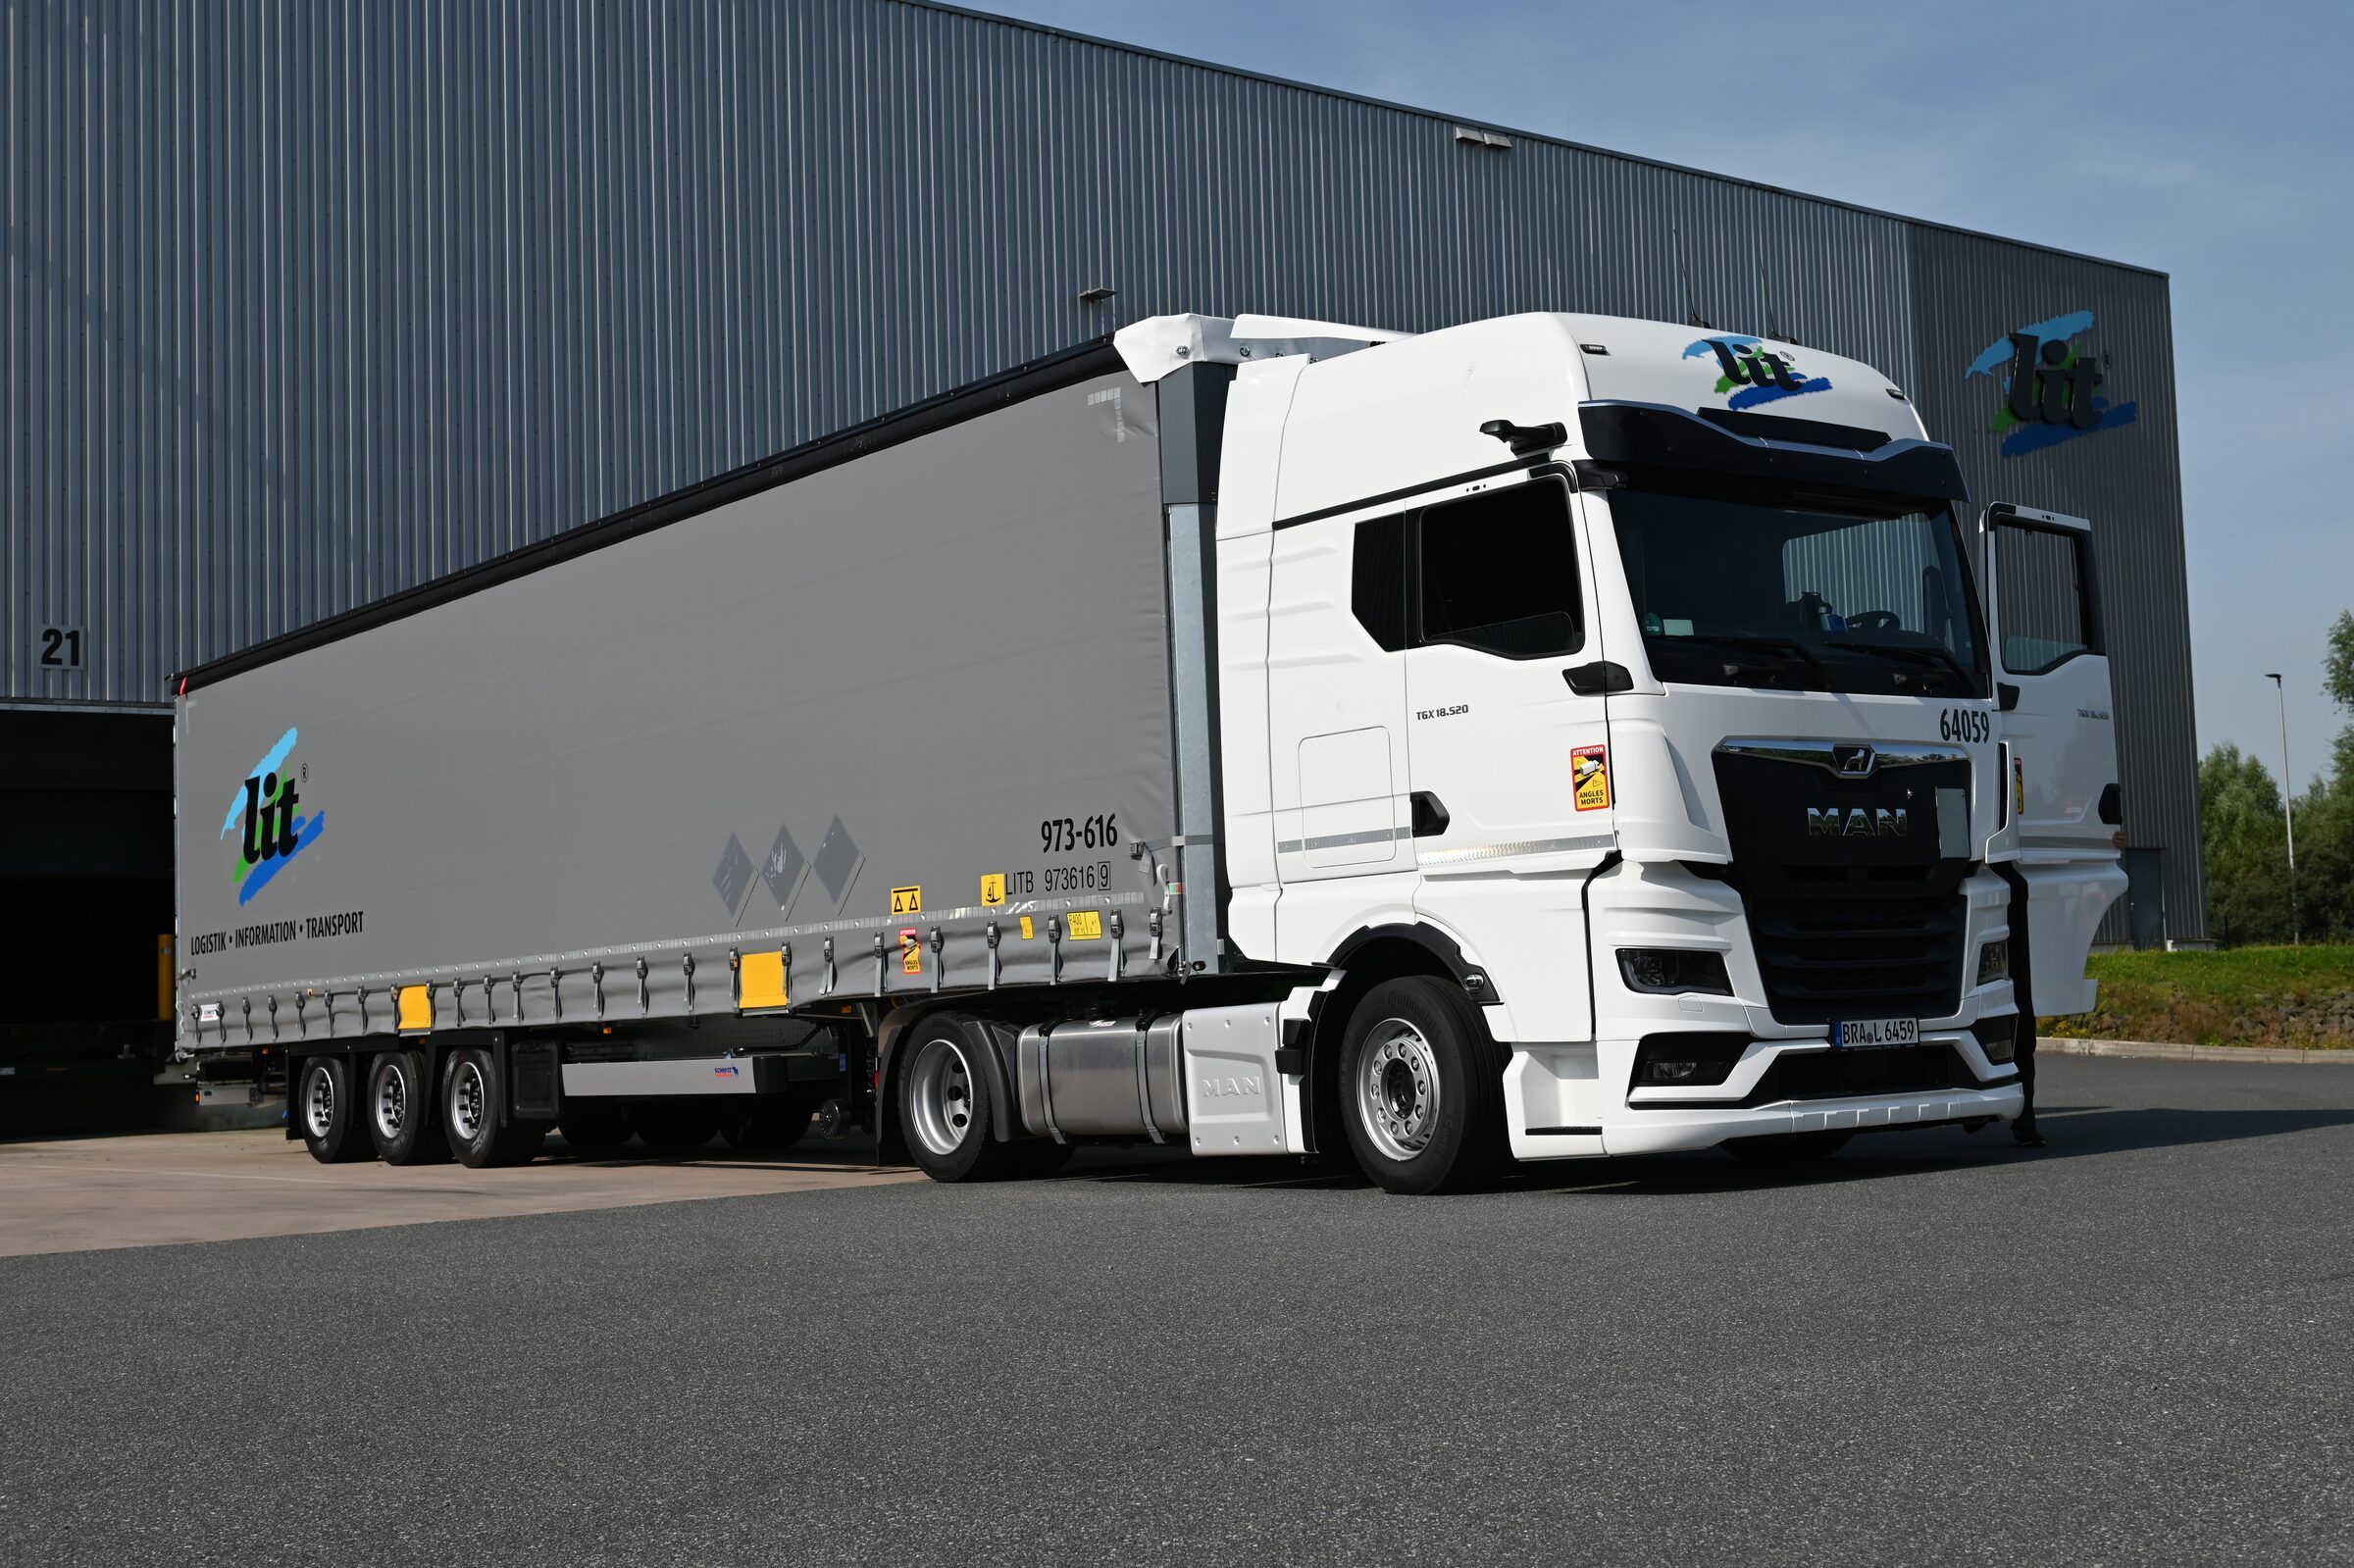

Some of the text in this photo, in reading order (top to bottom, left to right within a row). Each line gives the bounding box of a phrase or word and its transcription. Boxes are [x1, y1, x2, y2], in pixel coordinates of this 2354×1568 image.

[1701, 339, 1802, 391] lit
[2009, 332, 2103, 430] lit
[41, 629, 79, 666] 21
[1436, 704, 1468, 718] 18.520
[1939, 708, 1989, 743] 64059
[1572, 746, 1604, 756] ATTENTION
[1579, 789, 1605, 799] ANGLES
[1580, 796, 1604, 805] MORTS
[243, 772, 299, 864] lit
[1041, 813, 1117, 853] 973-616
[1807, 807, 1908, 836] MAN
[1004, 864, 1108, 895] LITB 973616 9
[190, 911, 364, 956] LOGISTIK INFORMATION TRANSPORT
[1842, 1020, 1915, 1044] BRA L 6459
[1202, 1076, 1260, 1097] MAN
